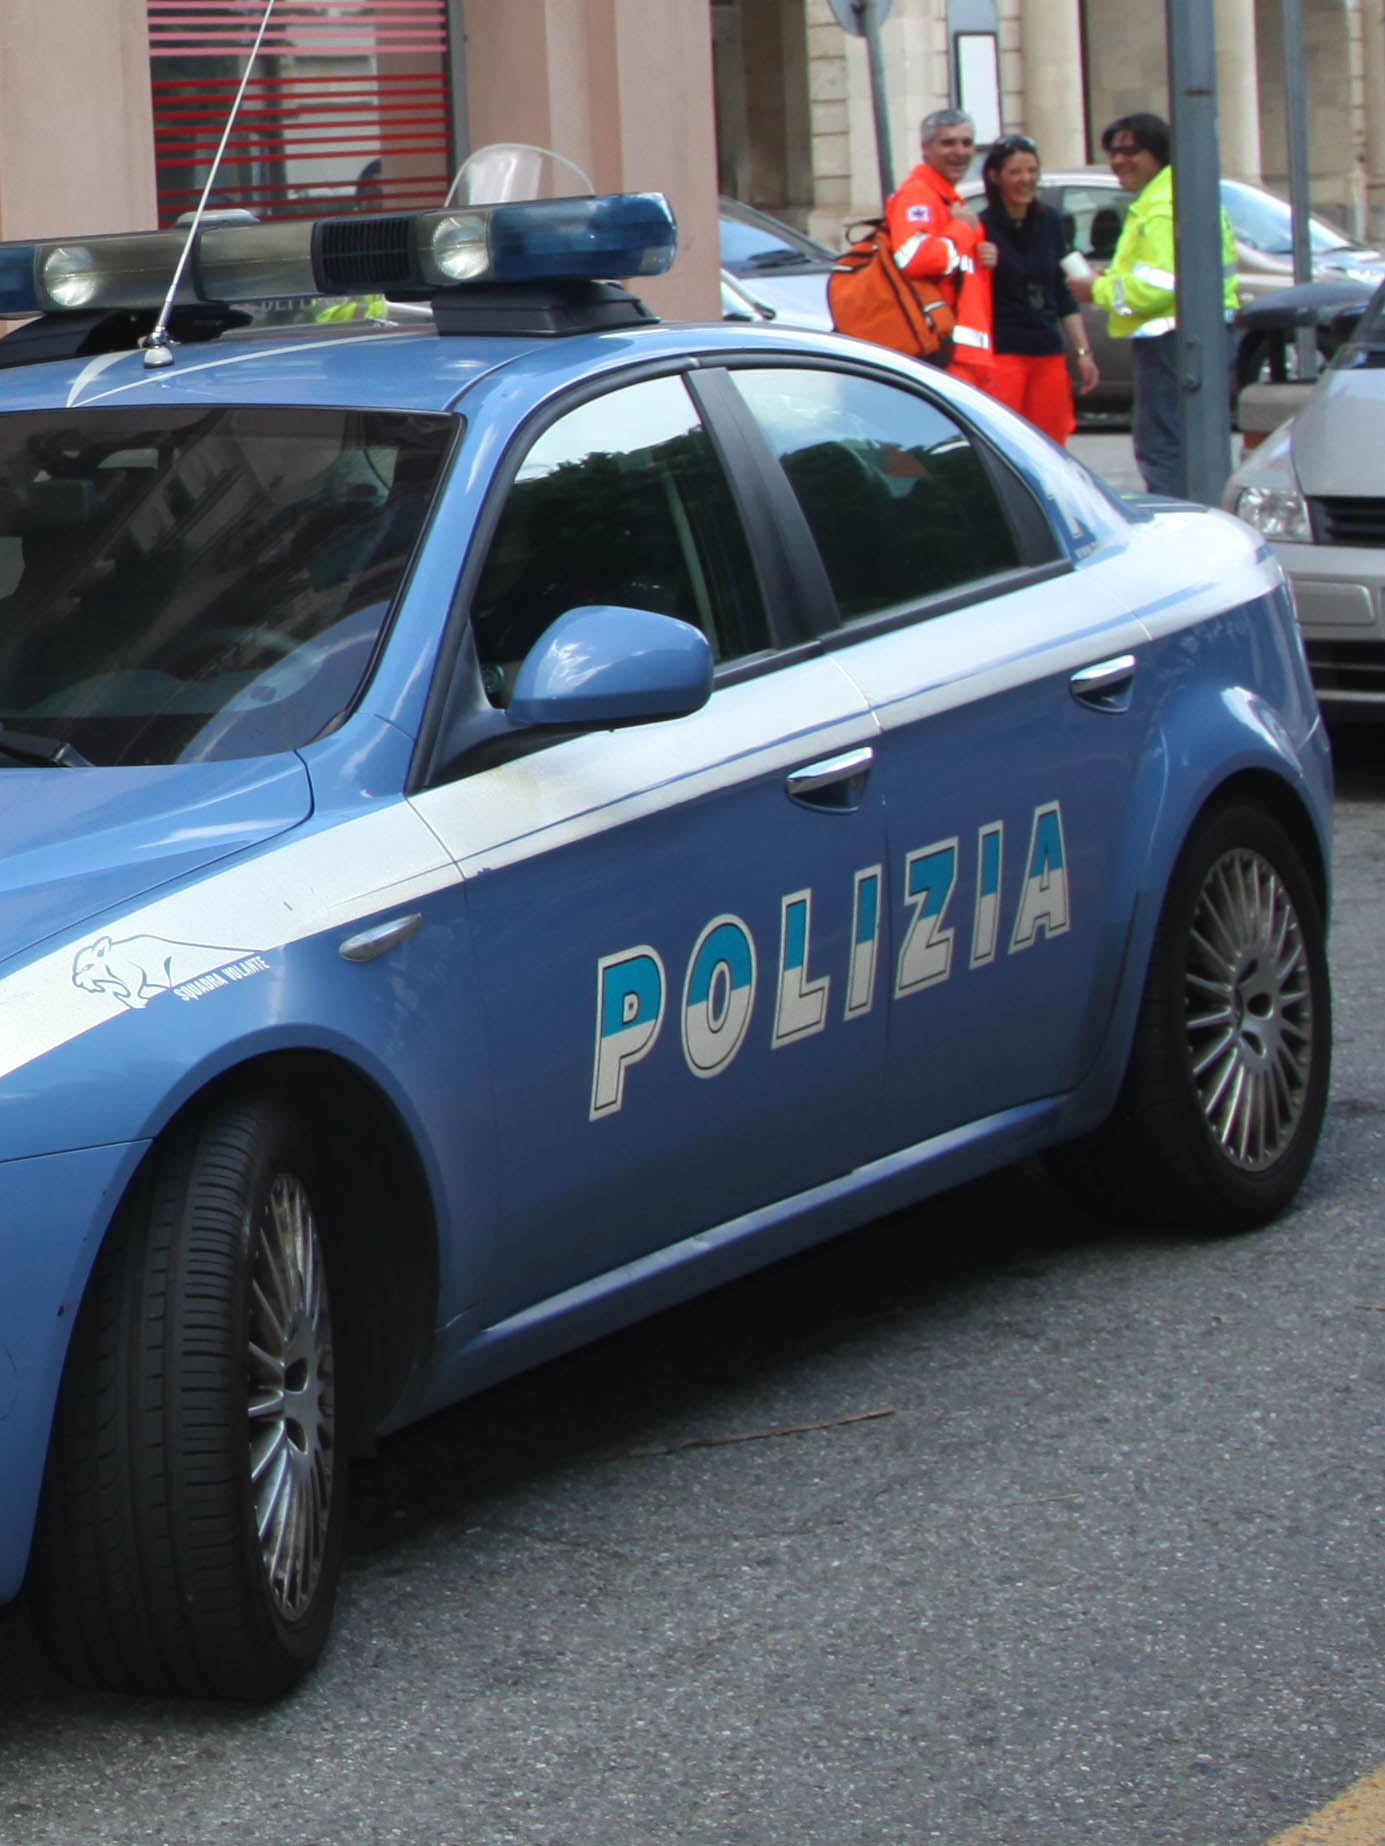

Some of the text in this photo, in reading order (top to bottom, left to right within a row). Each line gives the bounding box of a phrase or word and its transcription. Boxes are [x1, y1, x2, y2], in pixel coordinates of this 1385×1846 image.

[173, 955, 270, 1001] SQUADRA VOLANTE
[589, 800, 1070, 1121] POLIZIA
